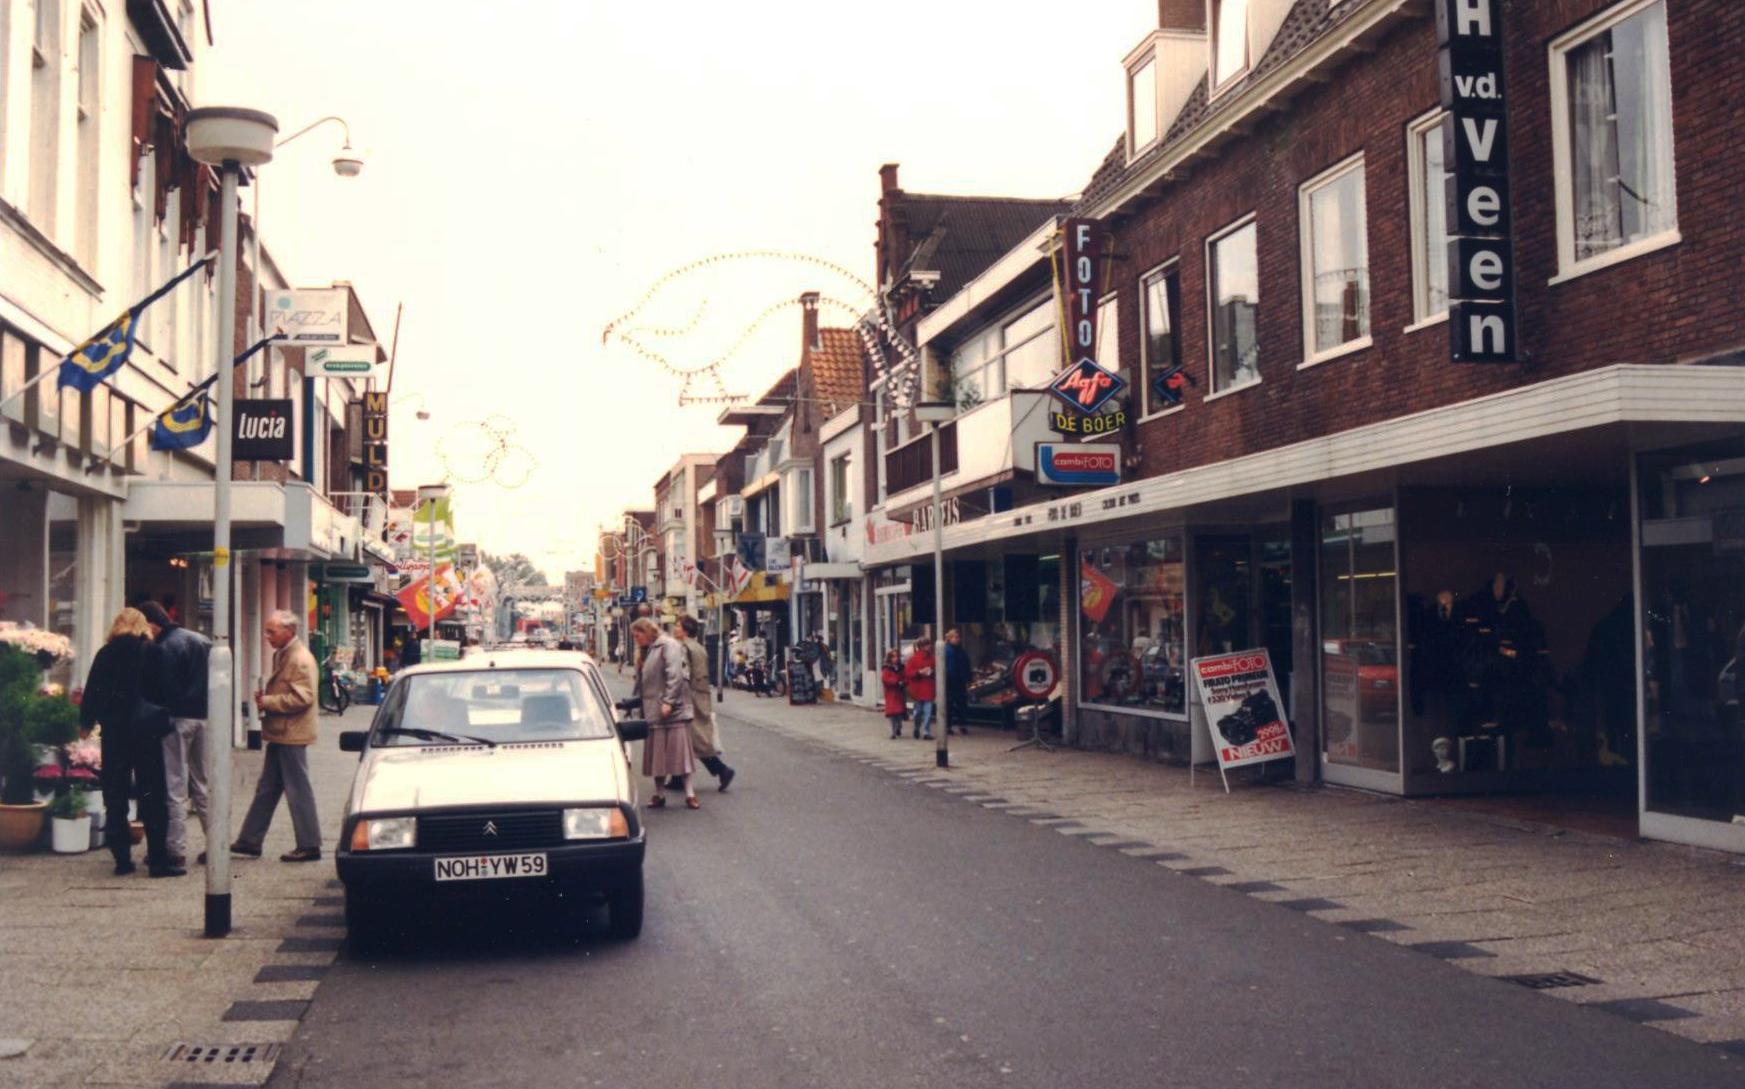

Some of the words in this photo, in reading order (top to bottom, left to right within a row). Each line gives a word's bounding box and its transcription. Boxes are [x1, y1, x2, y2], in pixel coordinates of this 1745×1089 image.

[1457, 0, 1492, 36] H
[1455, 73, 1502, 98] v.d.
[1461, 117, 1506, 354] Veen
[1076, 224, 1093, 347] FOTO
[1058, 368, 1113, 405] Agfa
[238, 409, 286, 439] Lucia
[1056, 413, 1077, 432] DE
[1083, 411, 1126, 433] BOER
[1230, 739, 1282, 760] NIEUW
[521, 856, 545, 874] 59
